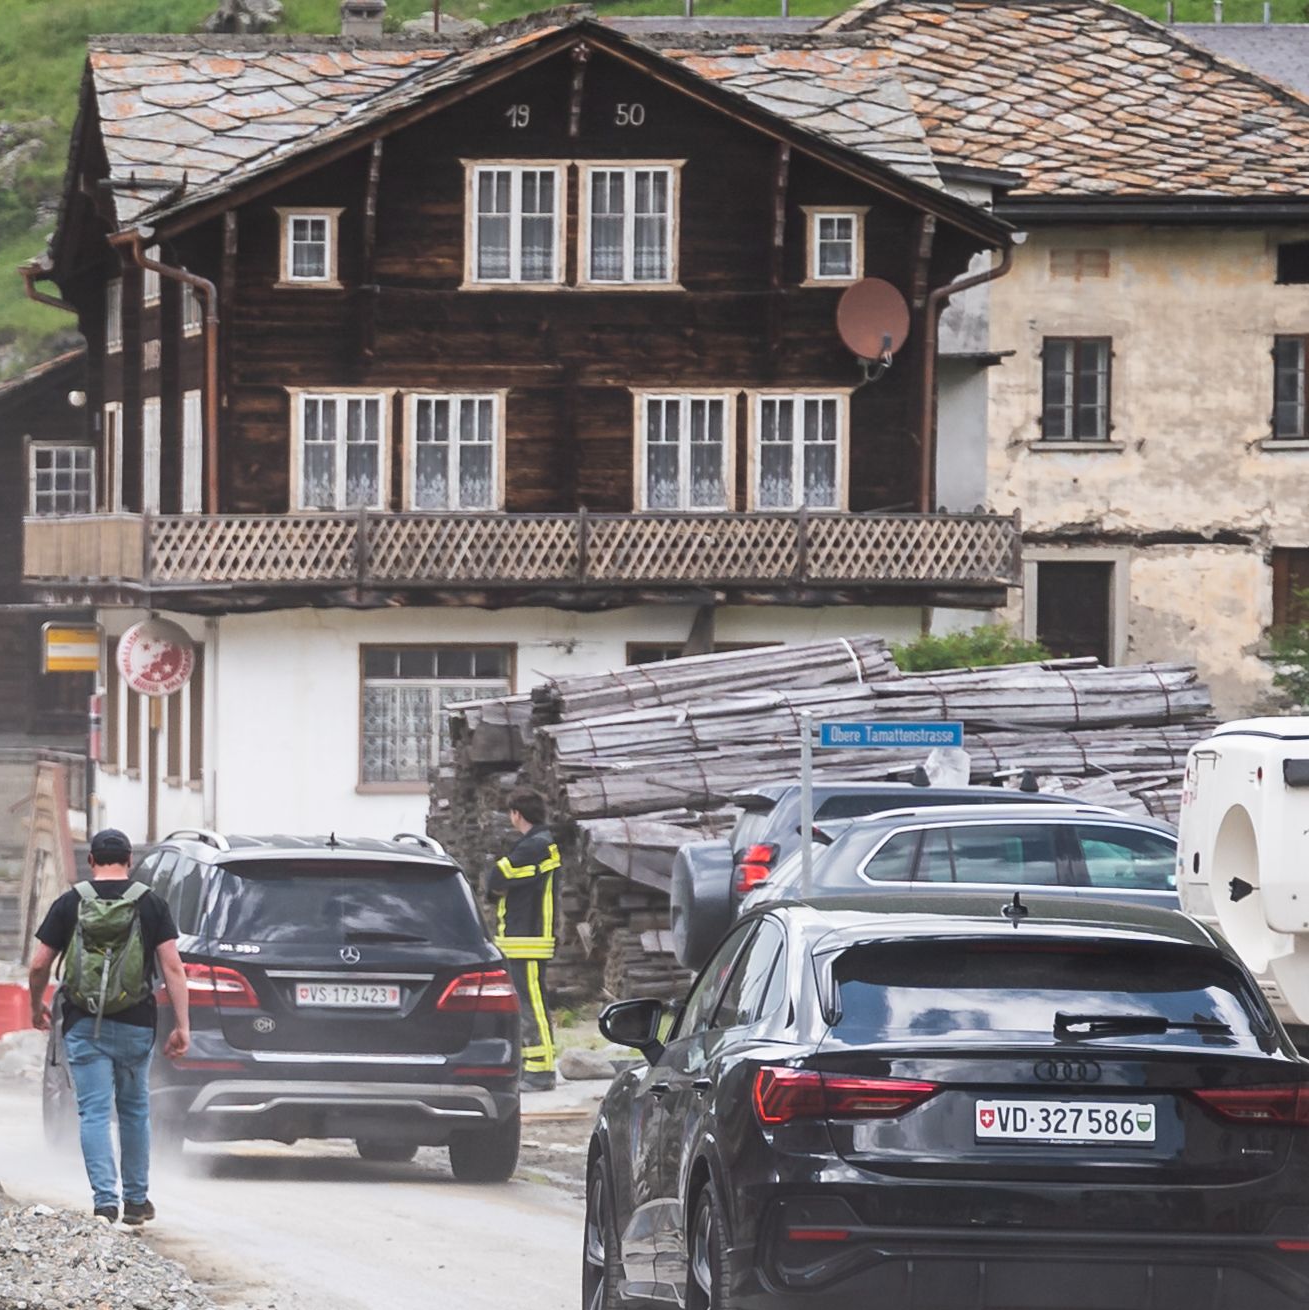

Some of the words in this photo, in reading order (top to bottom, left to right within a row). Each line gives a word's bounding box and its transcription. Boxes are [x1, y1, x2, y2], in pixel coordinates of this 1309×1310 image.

[504, 103, 531, 128] 19
[614, 103, 646, 126] 50
[830, 725, 862, 743] Obere
[866, 725, 955, 743] Tamattenstrasse
